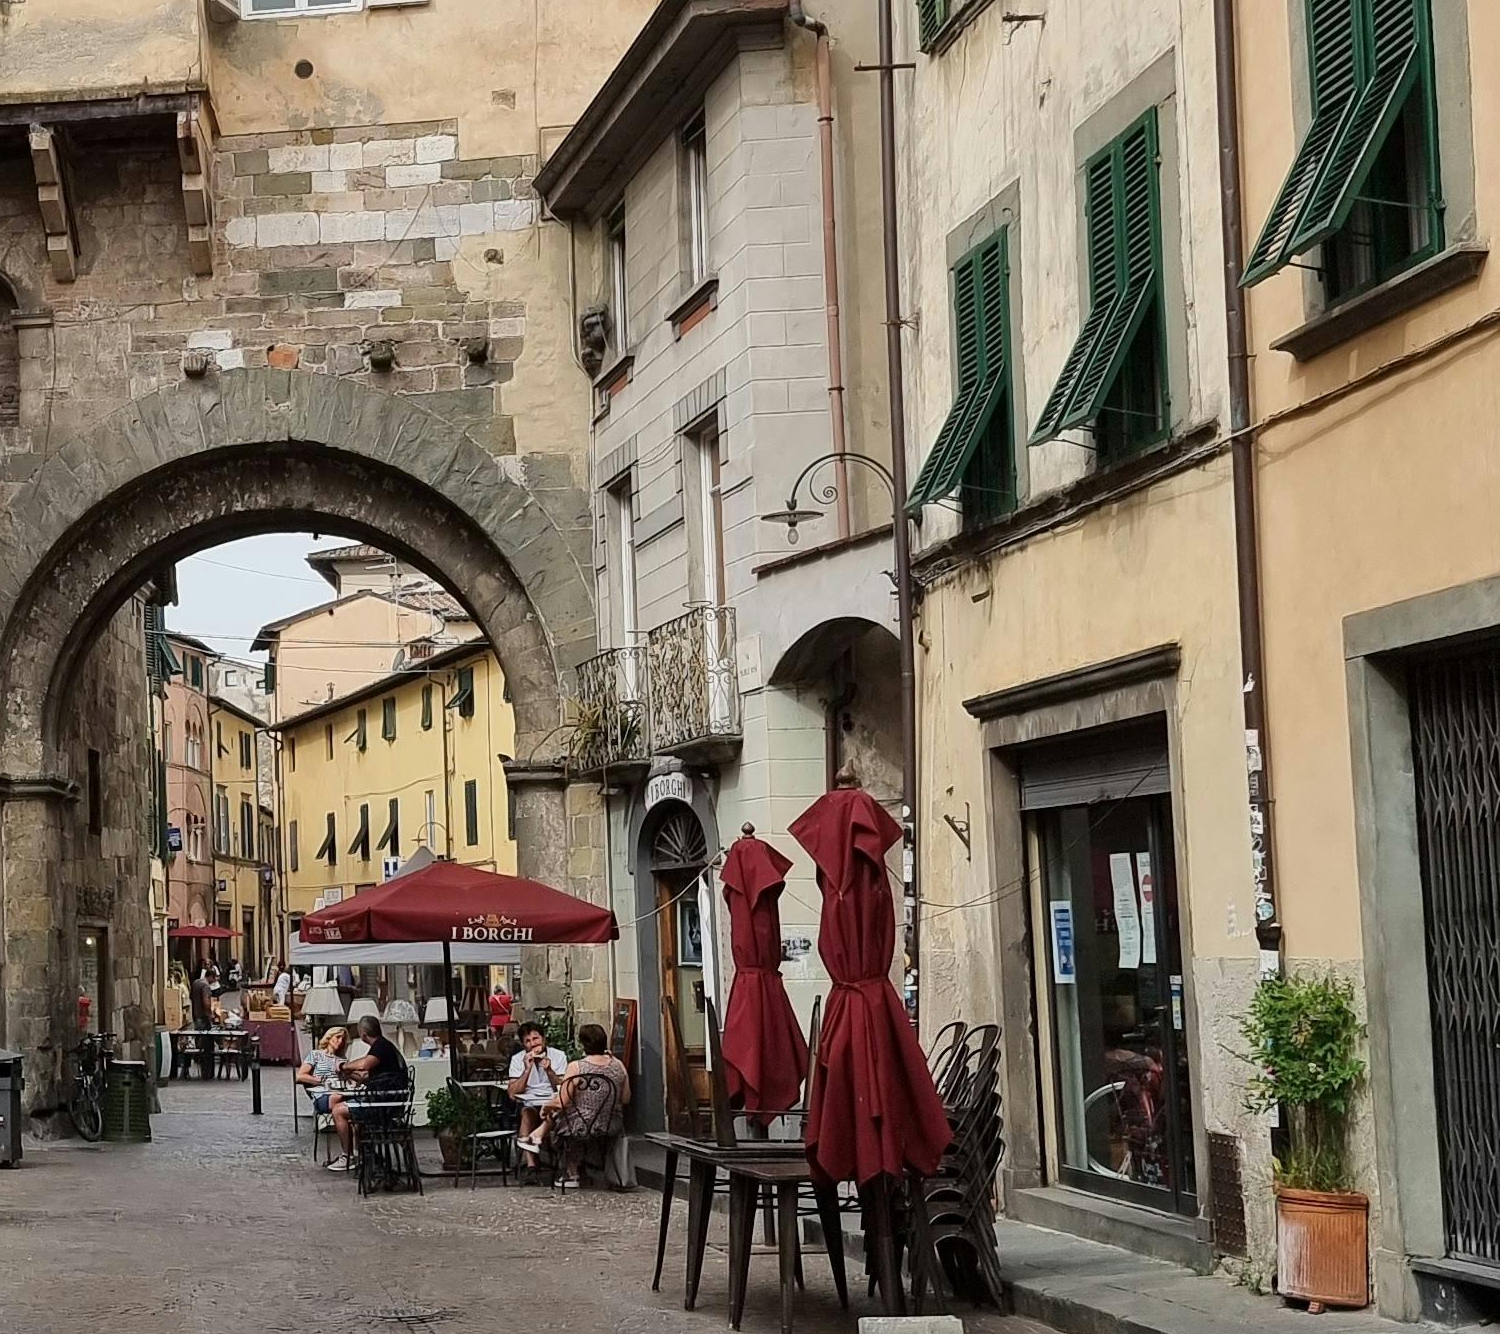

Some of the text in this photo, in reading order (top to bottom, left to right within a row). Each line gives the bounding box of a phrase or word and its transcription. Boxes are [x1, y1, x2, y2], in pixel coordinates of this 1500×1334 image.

[654, 778, 686, 800] BORGHI
[451, 926, 534, 941] I BORGHI
